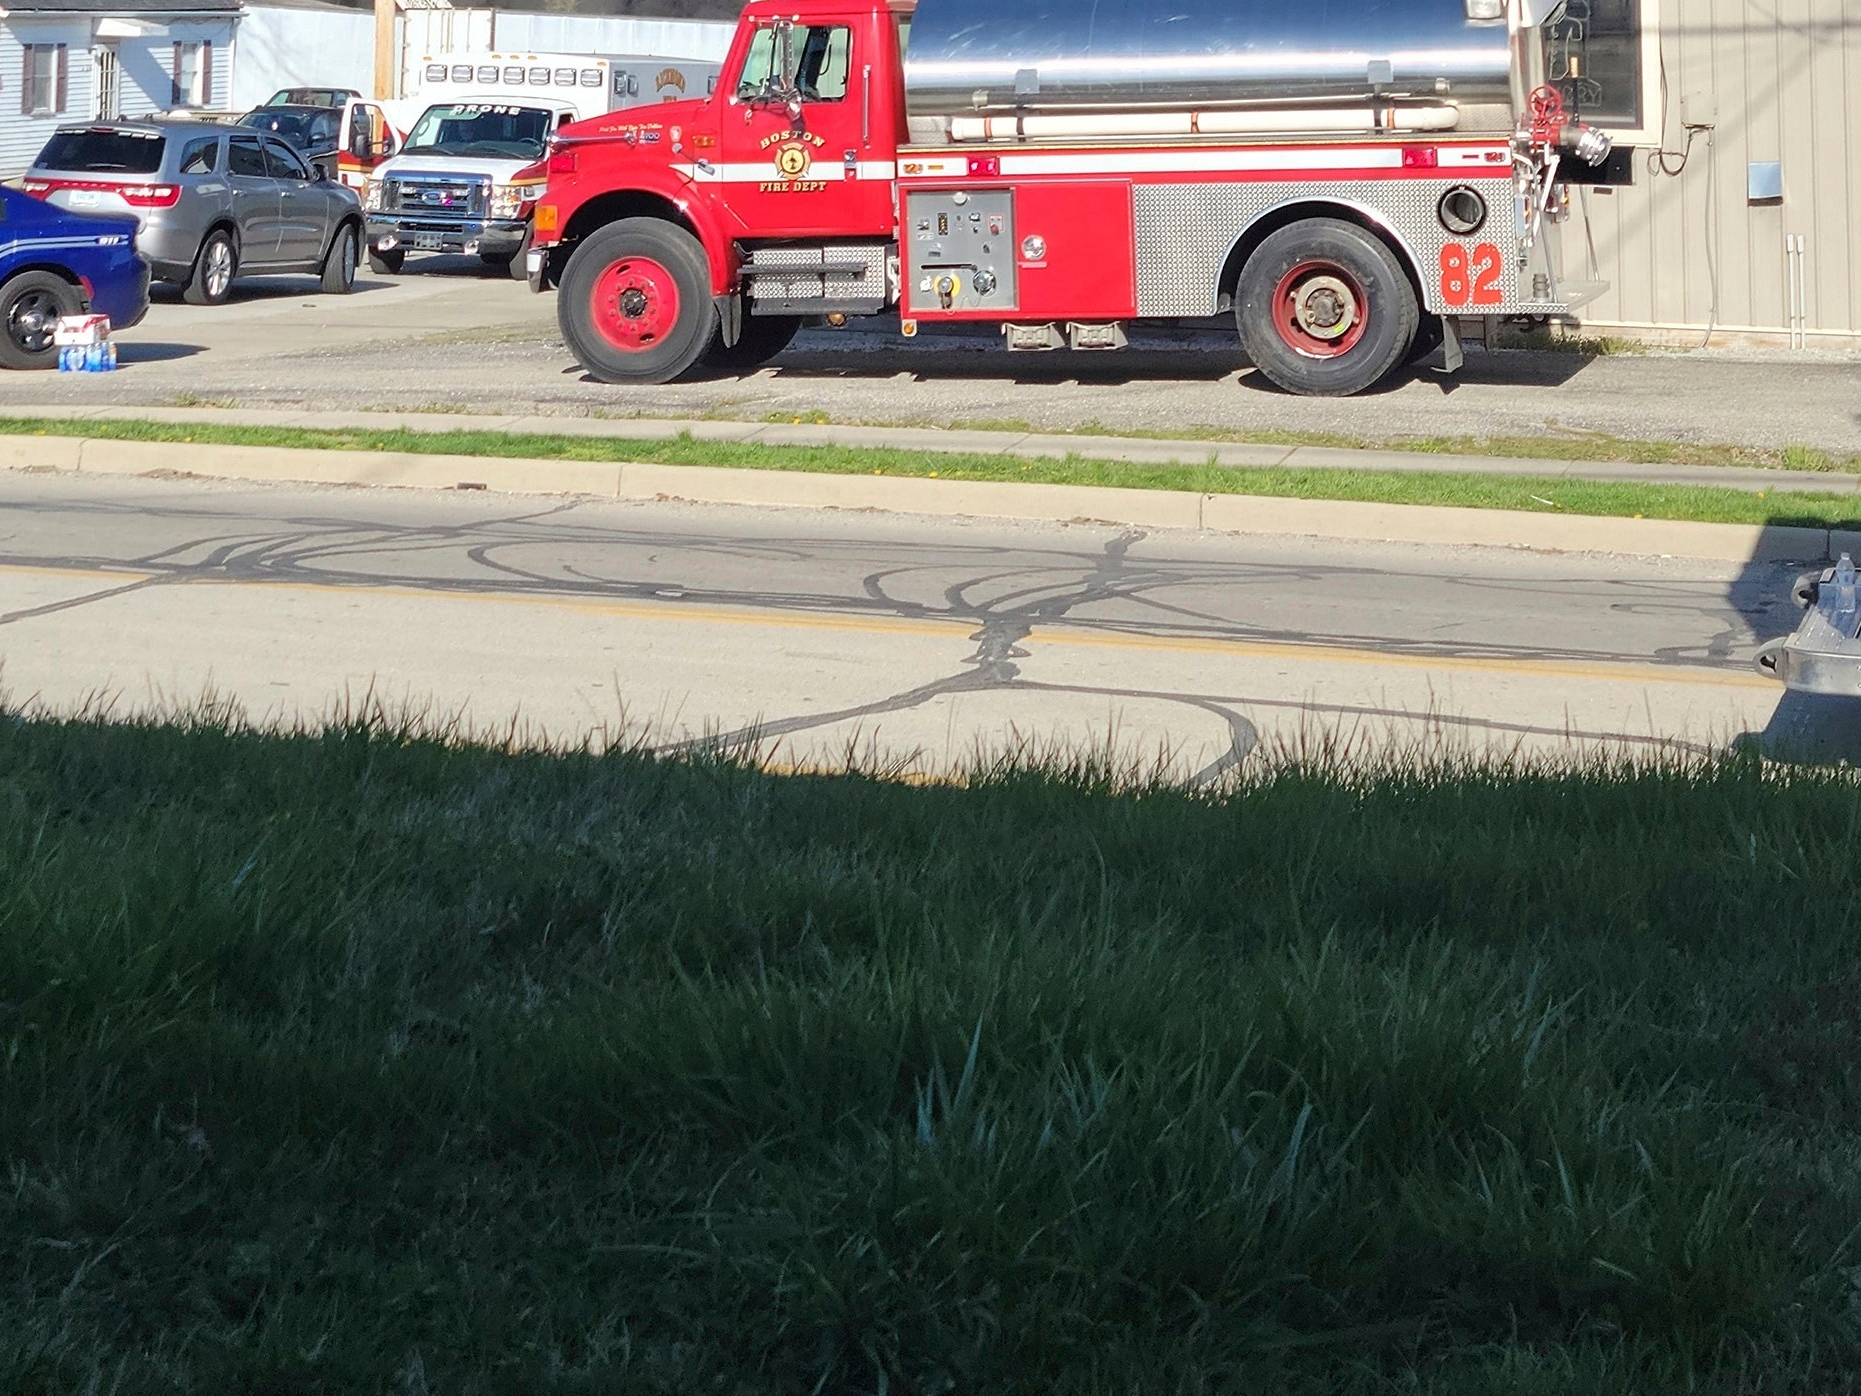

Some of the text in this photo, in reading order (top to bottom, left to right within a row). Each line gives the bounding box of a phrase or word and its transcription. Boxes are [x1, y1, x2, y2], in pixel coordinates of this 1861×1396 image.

[449, 104, 521, 116] DRONE
[759, 130, 826, 150] BOSTON
[759, 181, 827, 193] FIRE DEPT
[1439, 242, 1504, 307] 82
